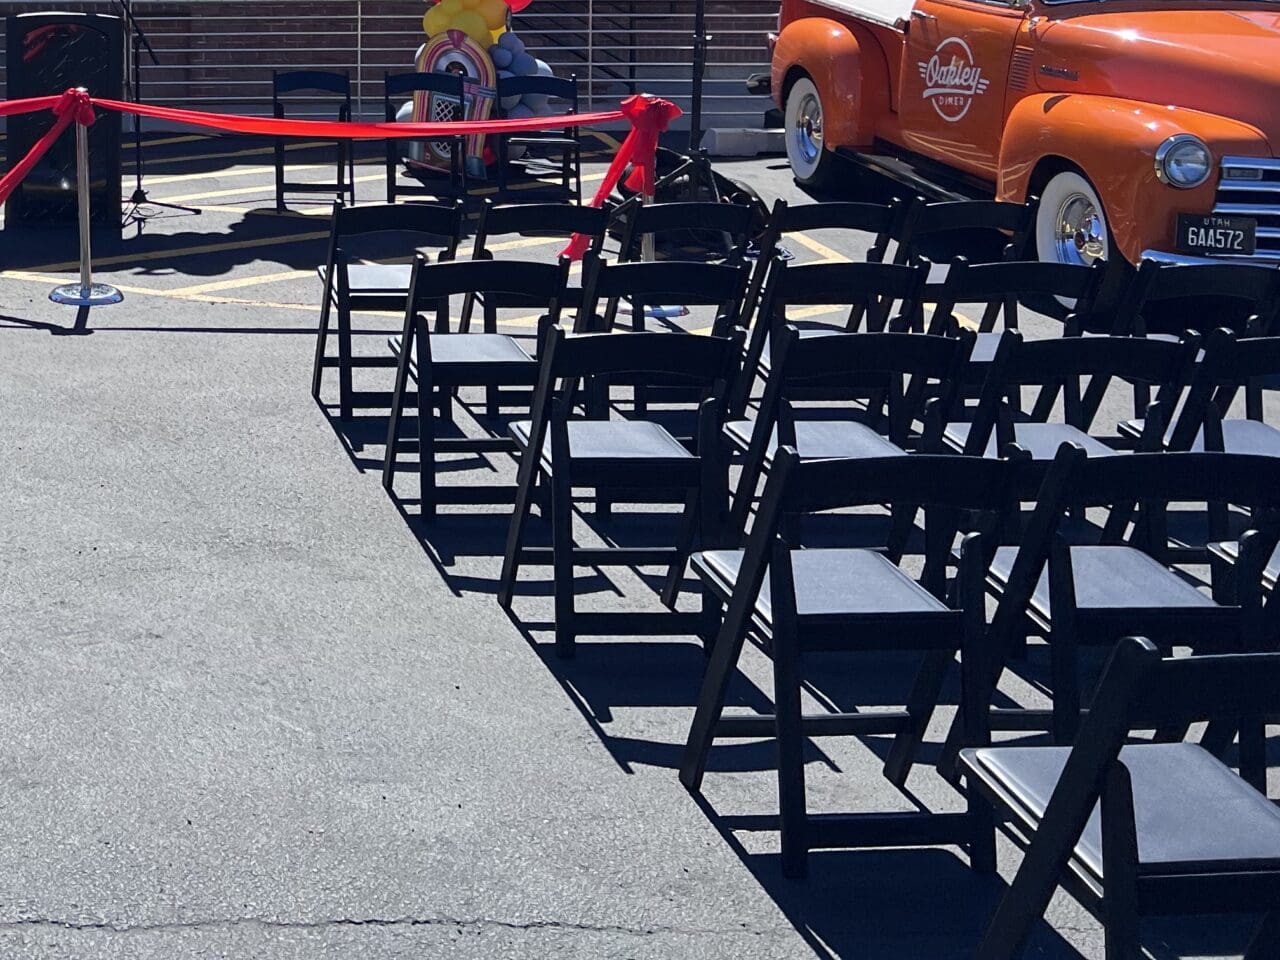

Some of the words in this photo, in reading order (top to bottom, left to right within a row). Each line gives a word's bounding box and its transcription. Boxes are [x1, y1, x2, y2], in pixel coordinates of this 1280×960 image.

[926, 54, 982, 94] Oakley
[939, 96, 964, 106] DINER
[1203, 217, 1230, 227] UTAH
[1188, 227, 1244, 250] 6AA572
